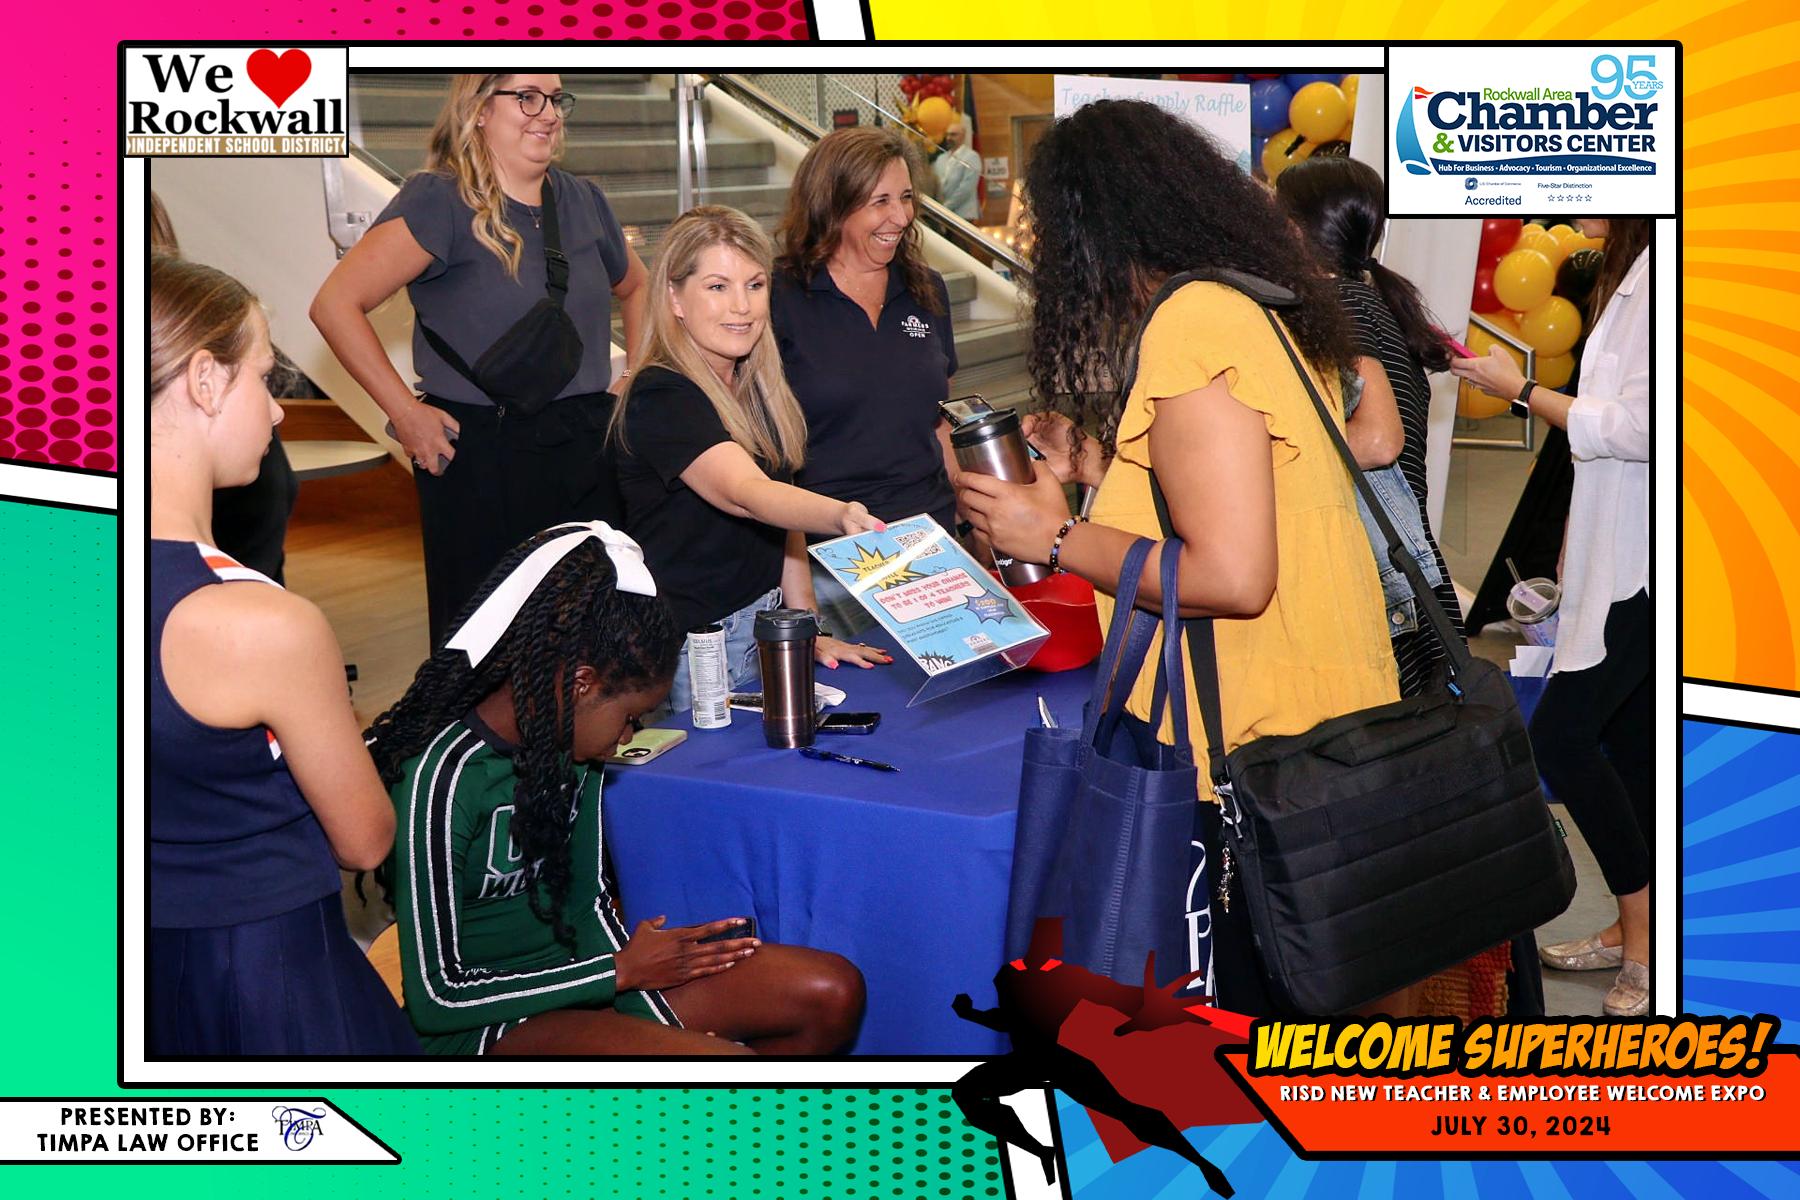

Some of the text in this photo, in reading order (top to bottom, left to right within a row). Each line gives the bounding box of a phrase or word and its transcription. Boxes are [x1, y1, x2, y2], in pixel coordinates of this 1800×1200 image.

[1195, 93, 1247, 116] Raffle
[880, 592, 902, 605] DON'T
[921, 581, 940, 591] YOUR
